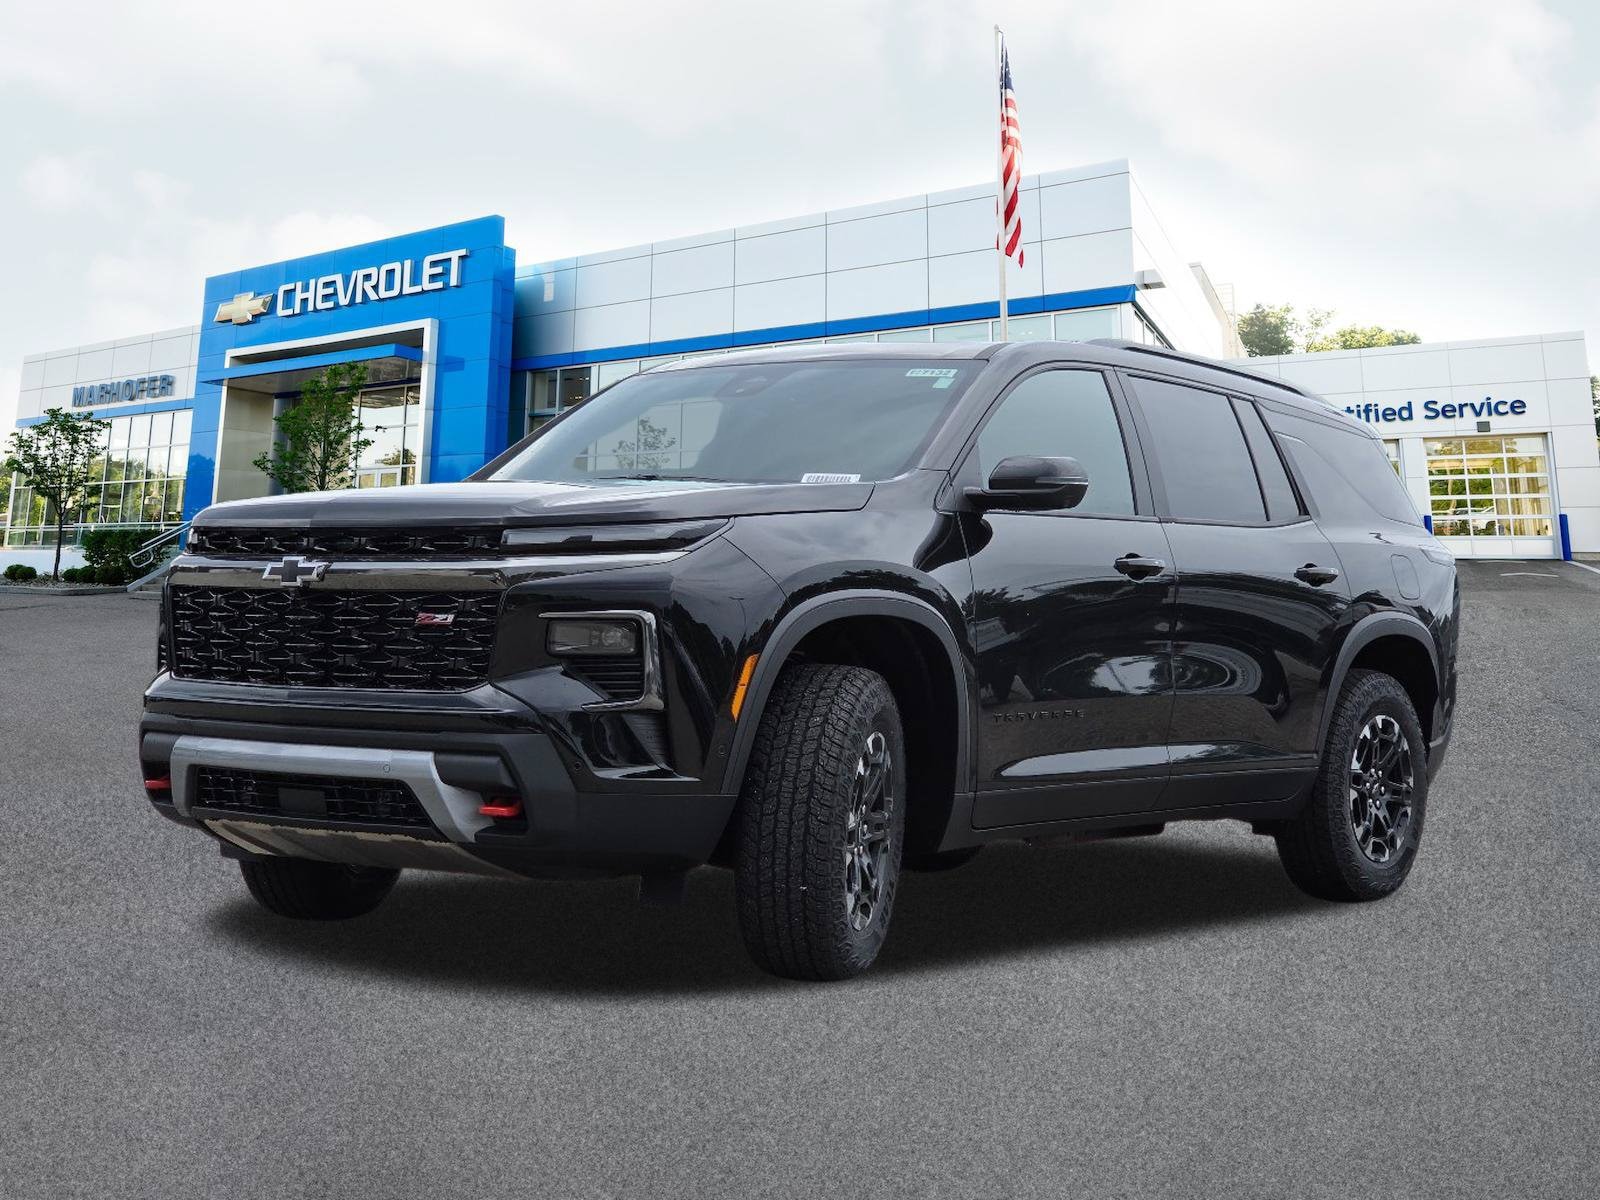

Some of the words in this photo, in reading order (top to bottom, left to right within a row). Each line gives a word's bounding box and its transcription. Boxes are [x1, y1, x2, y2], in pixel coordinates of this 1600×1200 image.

[276, 248, 470, 317] CHEVROLET
[72, 374, 175, 408] MARHOFER
[1423, 396, 1527, 421] Service
